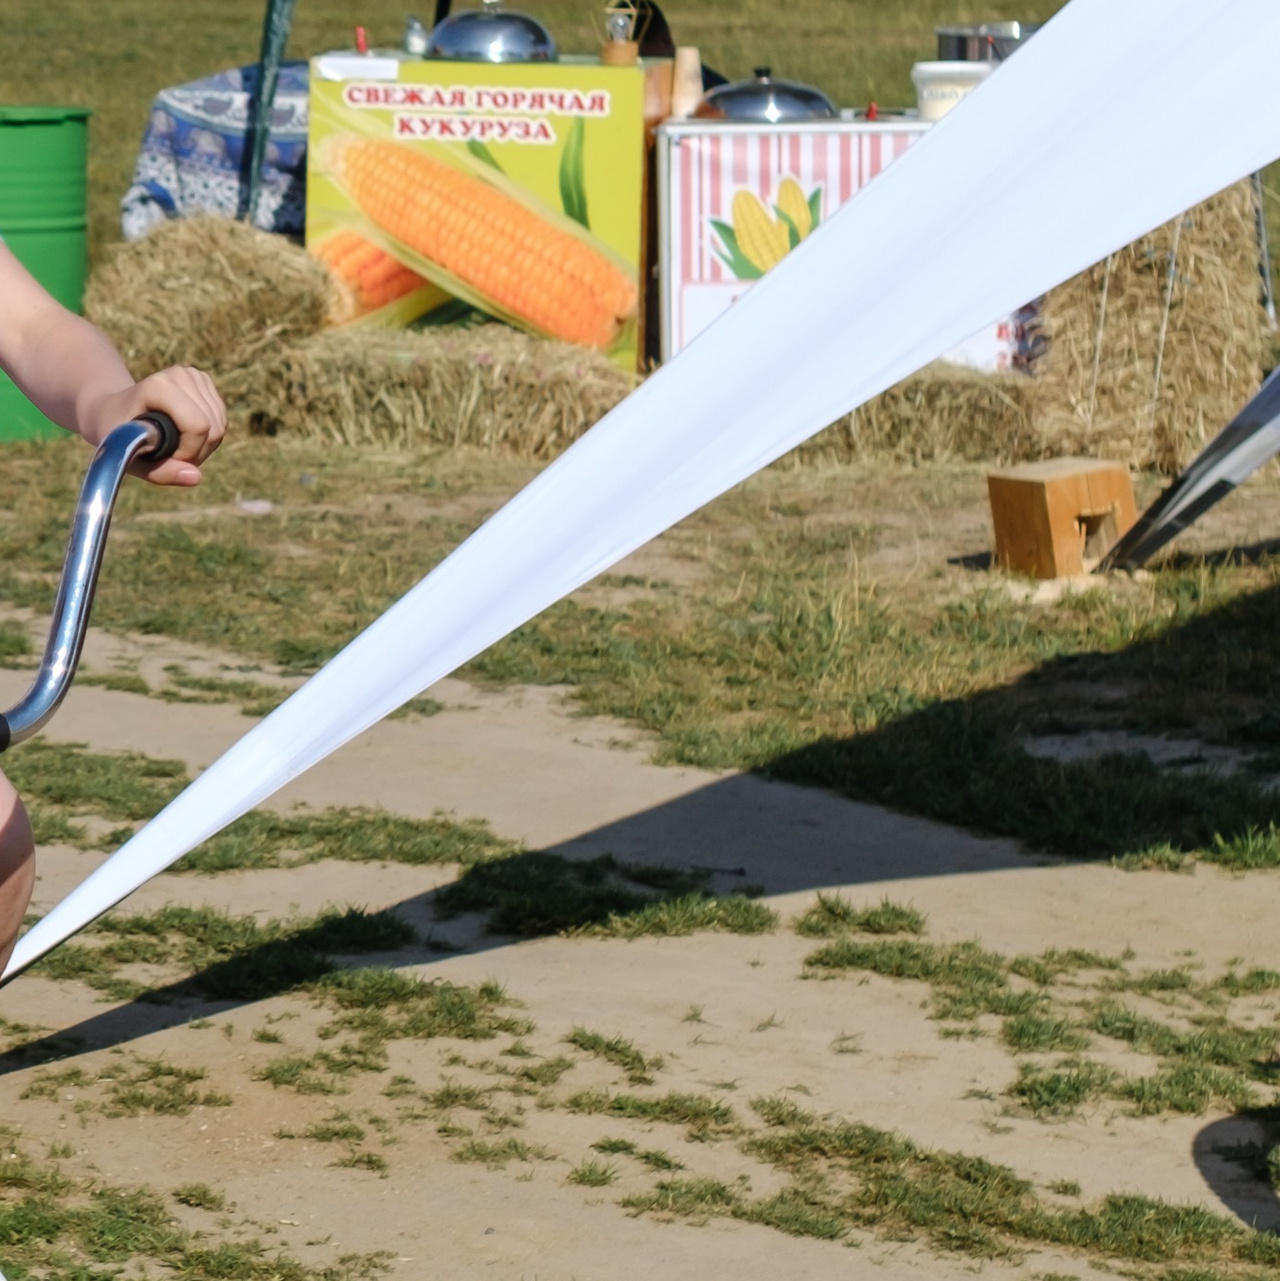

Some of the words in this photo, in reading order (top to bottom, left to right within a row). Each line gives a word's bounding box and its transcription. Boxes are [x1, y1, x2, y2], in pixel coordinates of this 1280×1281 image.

[346, 86, 467, 107] СВЕЖАЯ
[475, 90, 606, 112] ГОРЯЧАЯ
[397, 116, 552, 140] КУКУРУЗА
